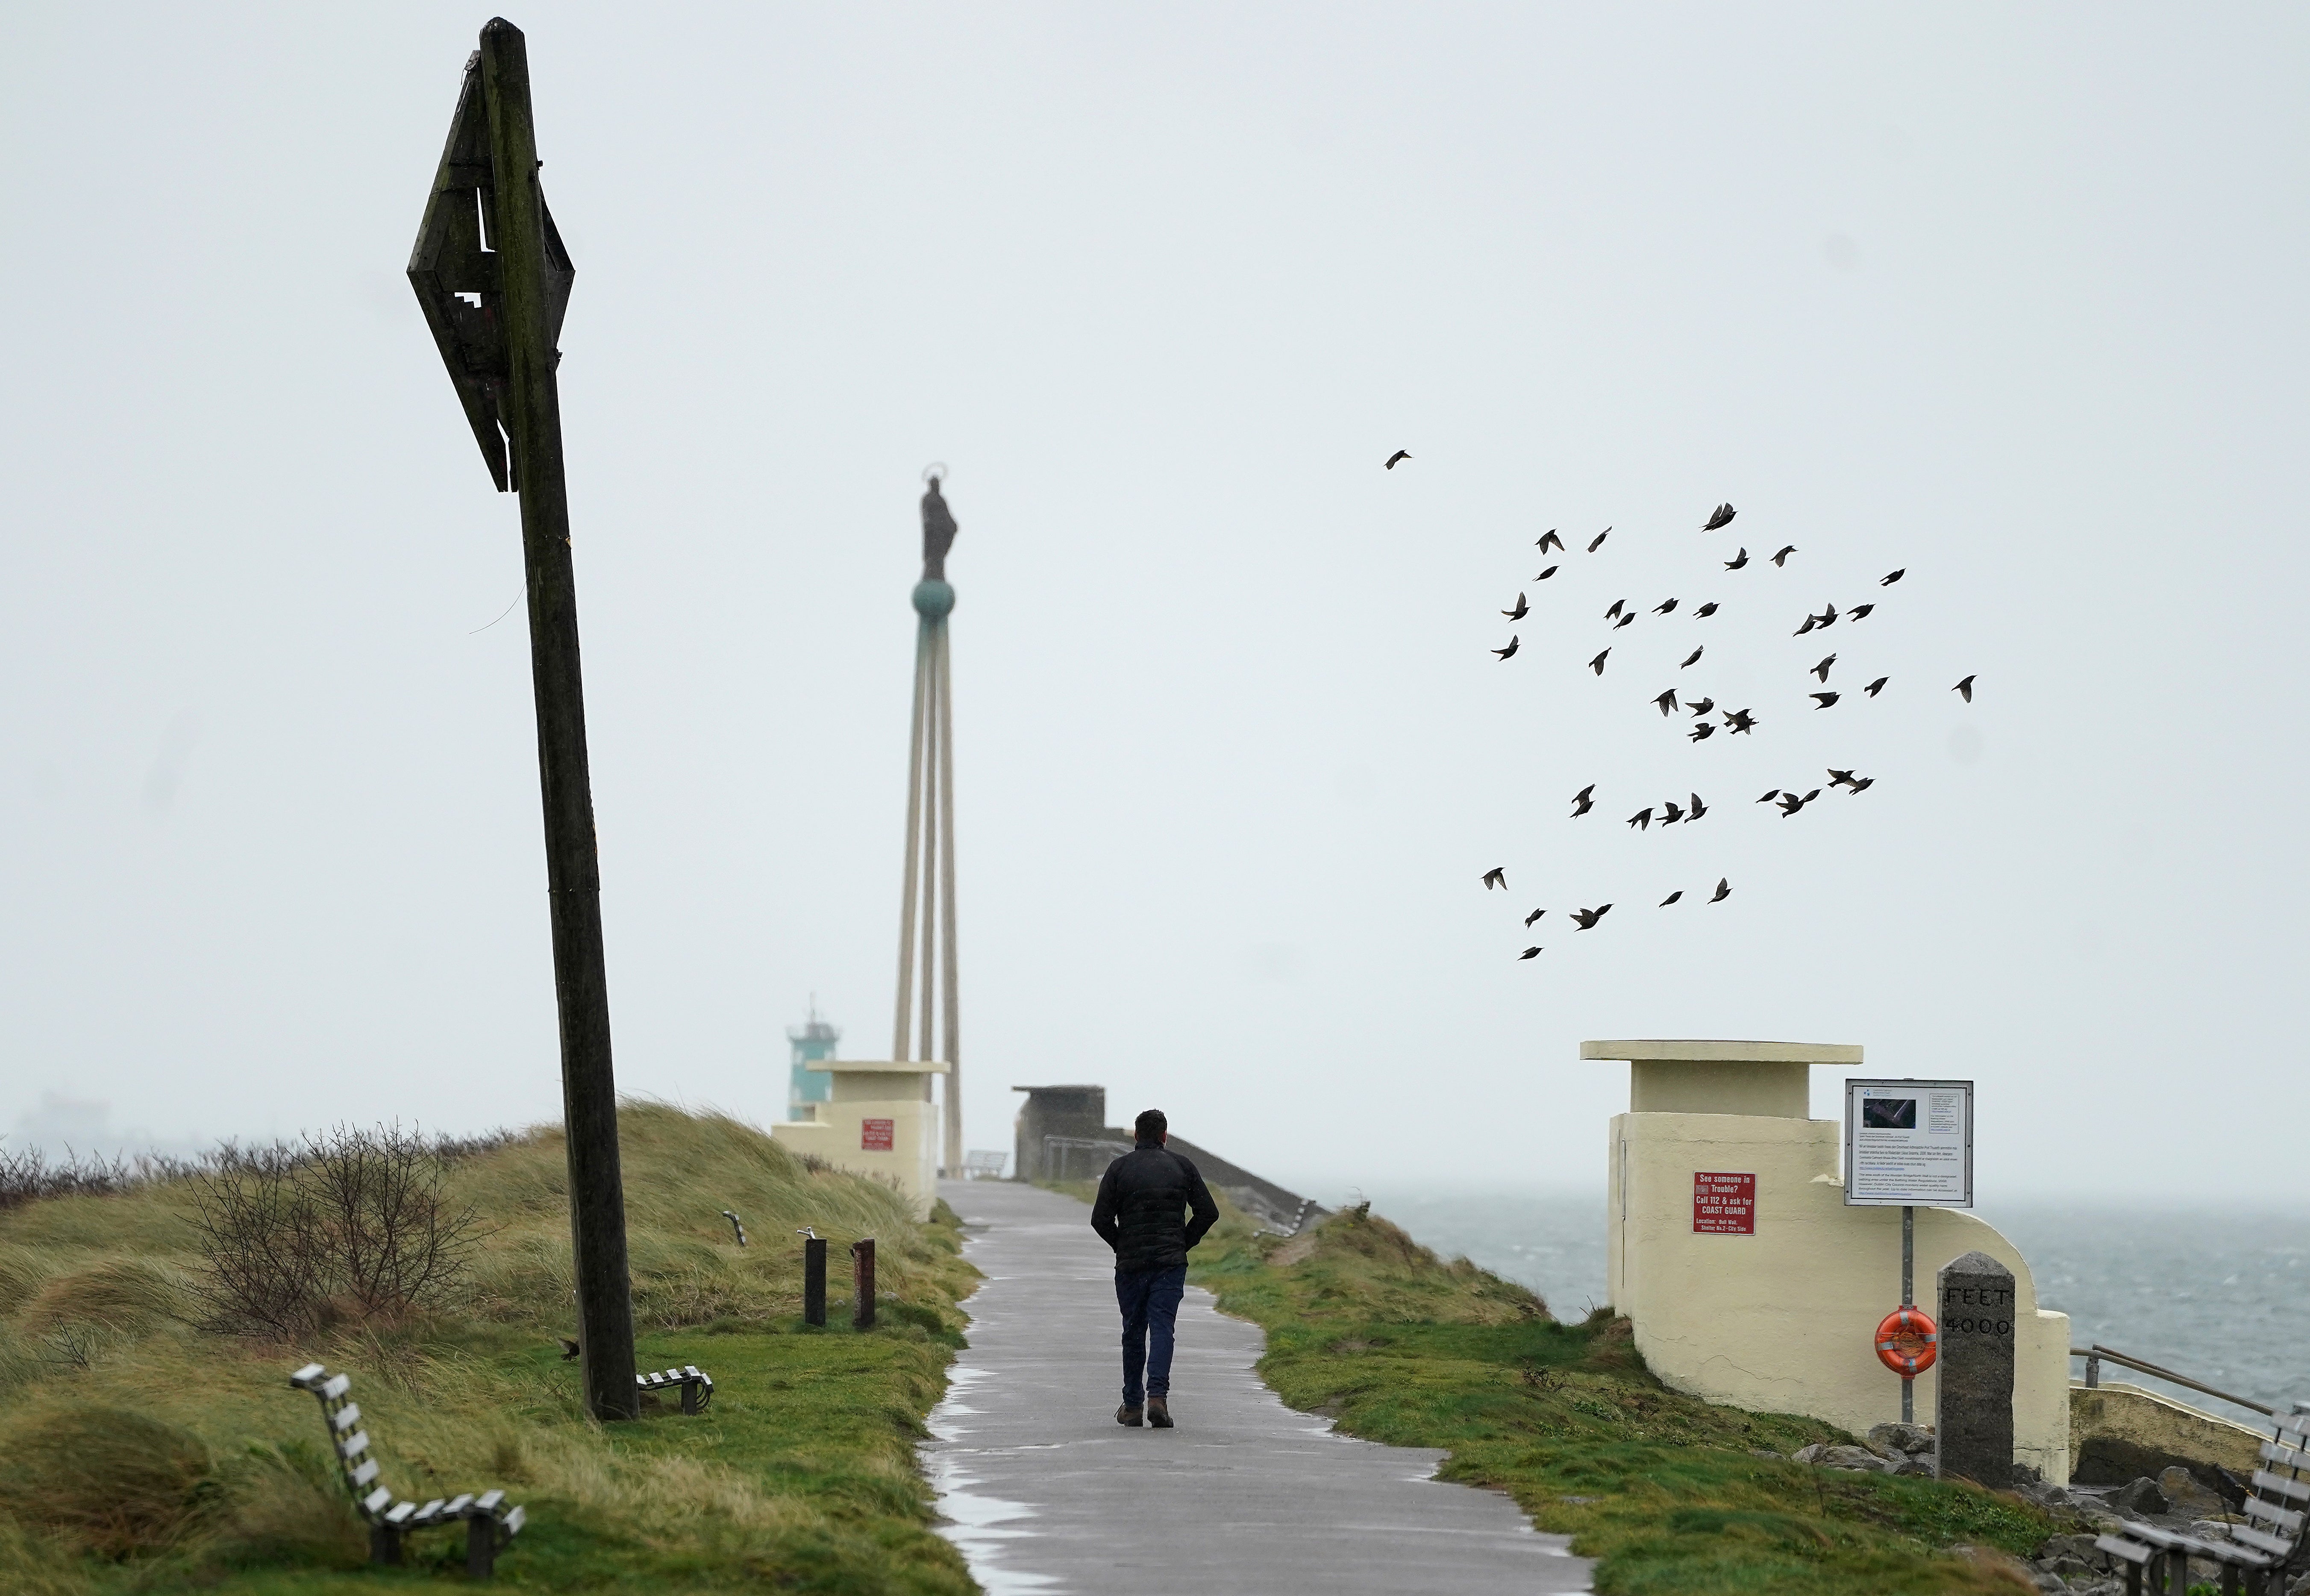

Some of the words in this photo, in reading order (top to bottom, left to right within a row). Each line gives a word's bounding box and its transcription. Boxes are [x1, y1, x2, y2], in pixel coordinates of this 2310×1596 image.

[1700, 1174, 1711, 1182] See
[1711, 1185, 1738, 1193] Trouble?
[1947, 1288, 2010, 1306] FEET
[1946, 1319, 2009, 1334] 4000
